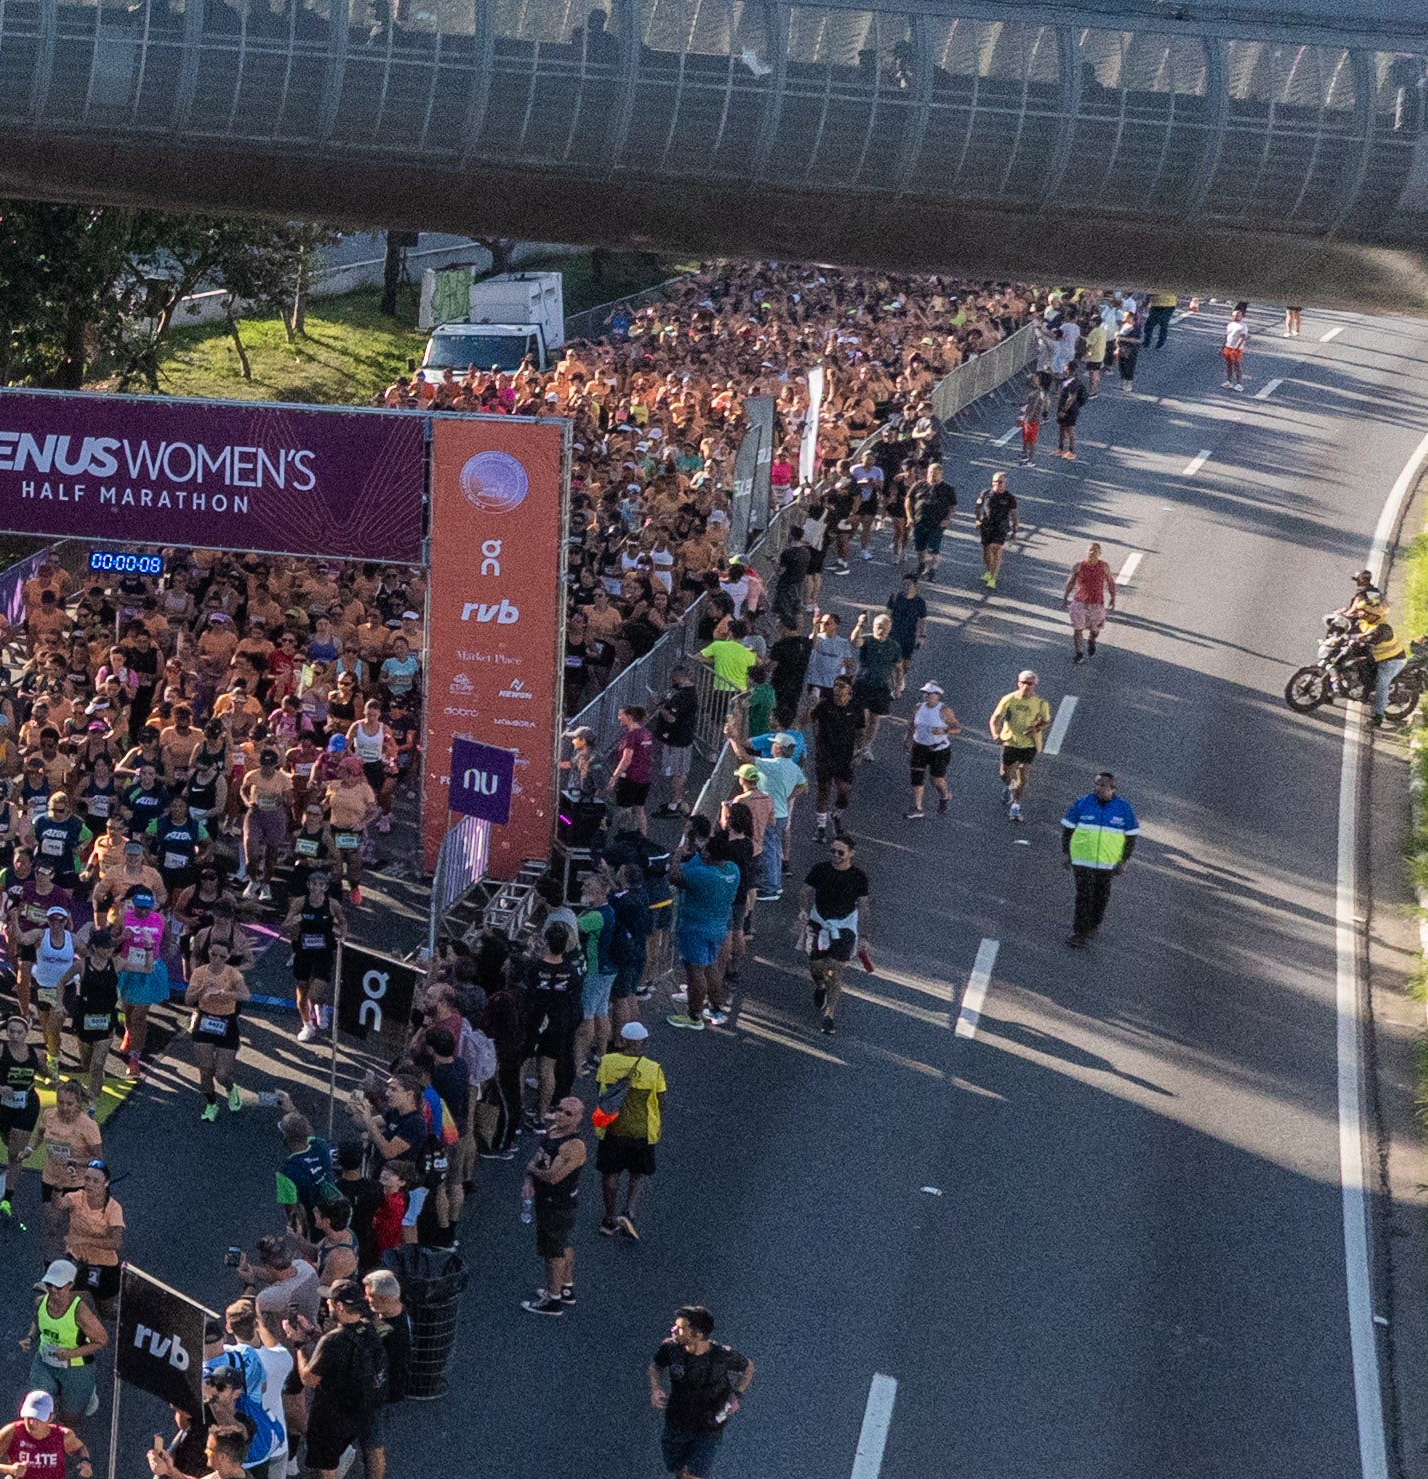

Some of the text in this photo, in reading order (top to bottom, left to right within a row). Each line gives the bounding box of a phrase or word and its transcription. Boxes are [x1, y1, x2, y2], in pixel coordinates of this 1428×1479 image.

[122, 438, 316, 491] WOMEN'S
[21, 480, 249, 514] HALF MARATHON
[460, 599, 520, 624] rvb
[463, 768, 499, 795] nu
[133, 1323, 189, 1372] rvb
